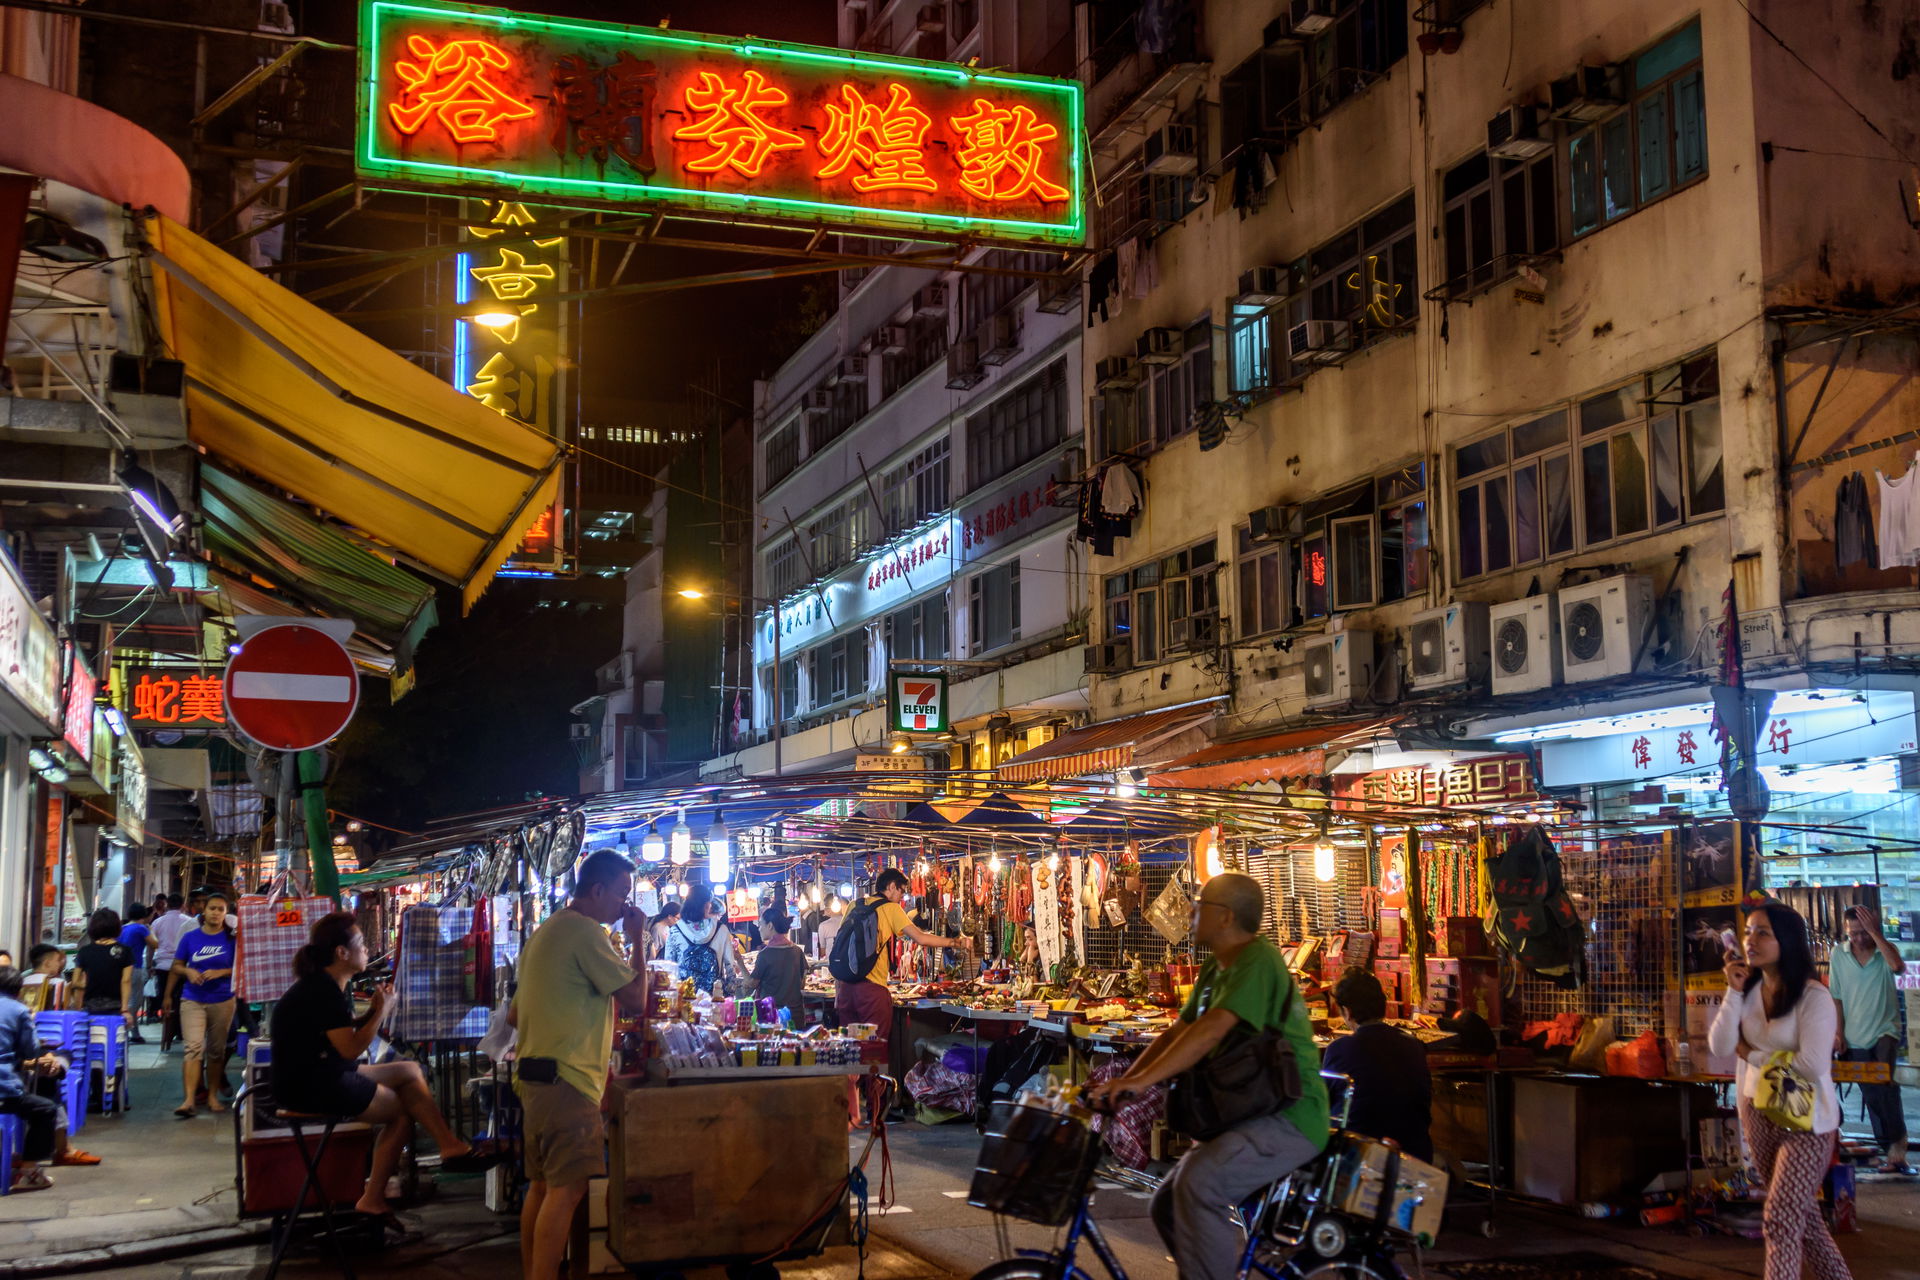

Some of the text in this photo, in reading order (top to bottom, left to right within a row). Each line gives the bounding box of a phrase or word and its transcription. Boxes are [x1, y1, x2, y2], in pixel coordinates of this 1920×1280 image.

[1743, 619, 1769, 633] Street
[132, 673, 226, 724] 蛇羹
[904, 682, 936, 729] 7
[1631, 718, 1793, 770] 偉發行
[279, 912, 299, 924] 20
[200, 945, 223, 955] NIKE
[1695, 994, 1711, 1006] SKY
